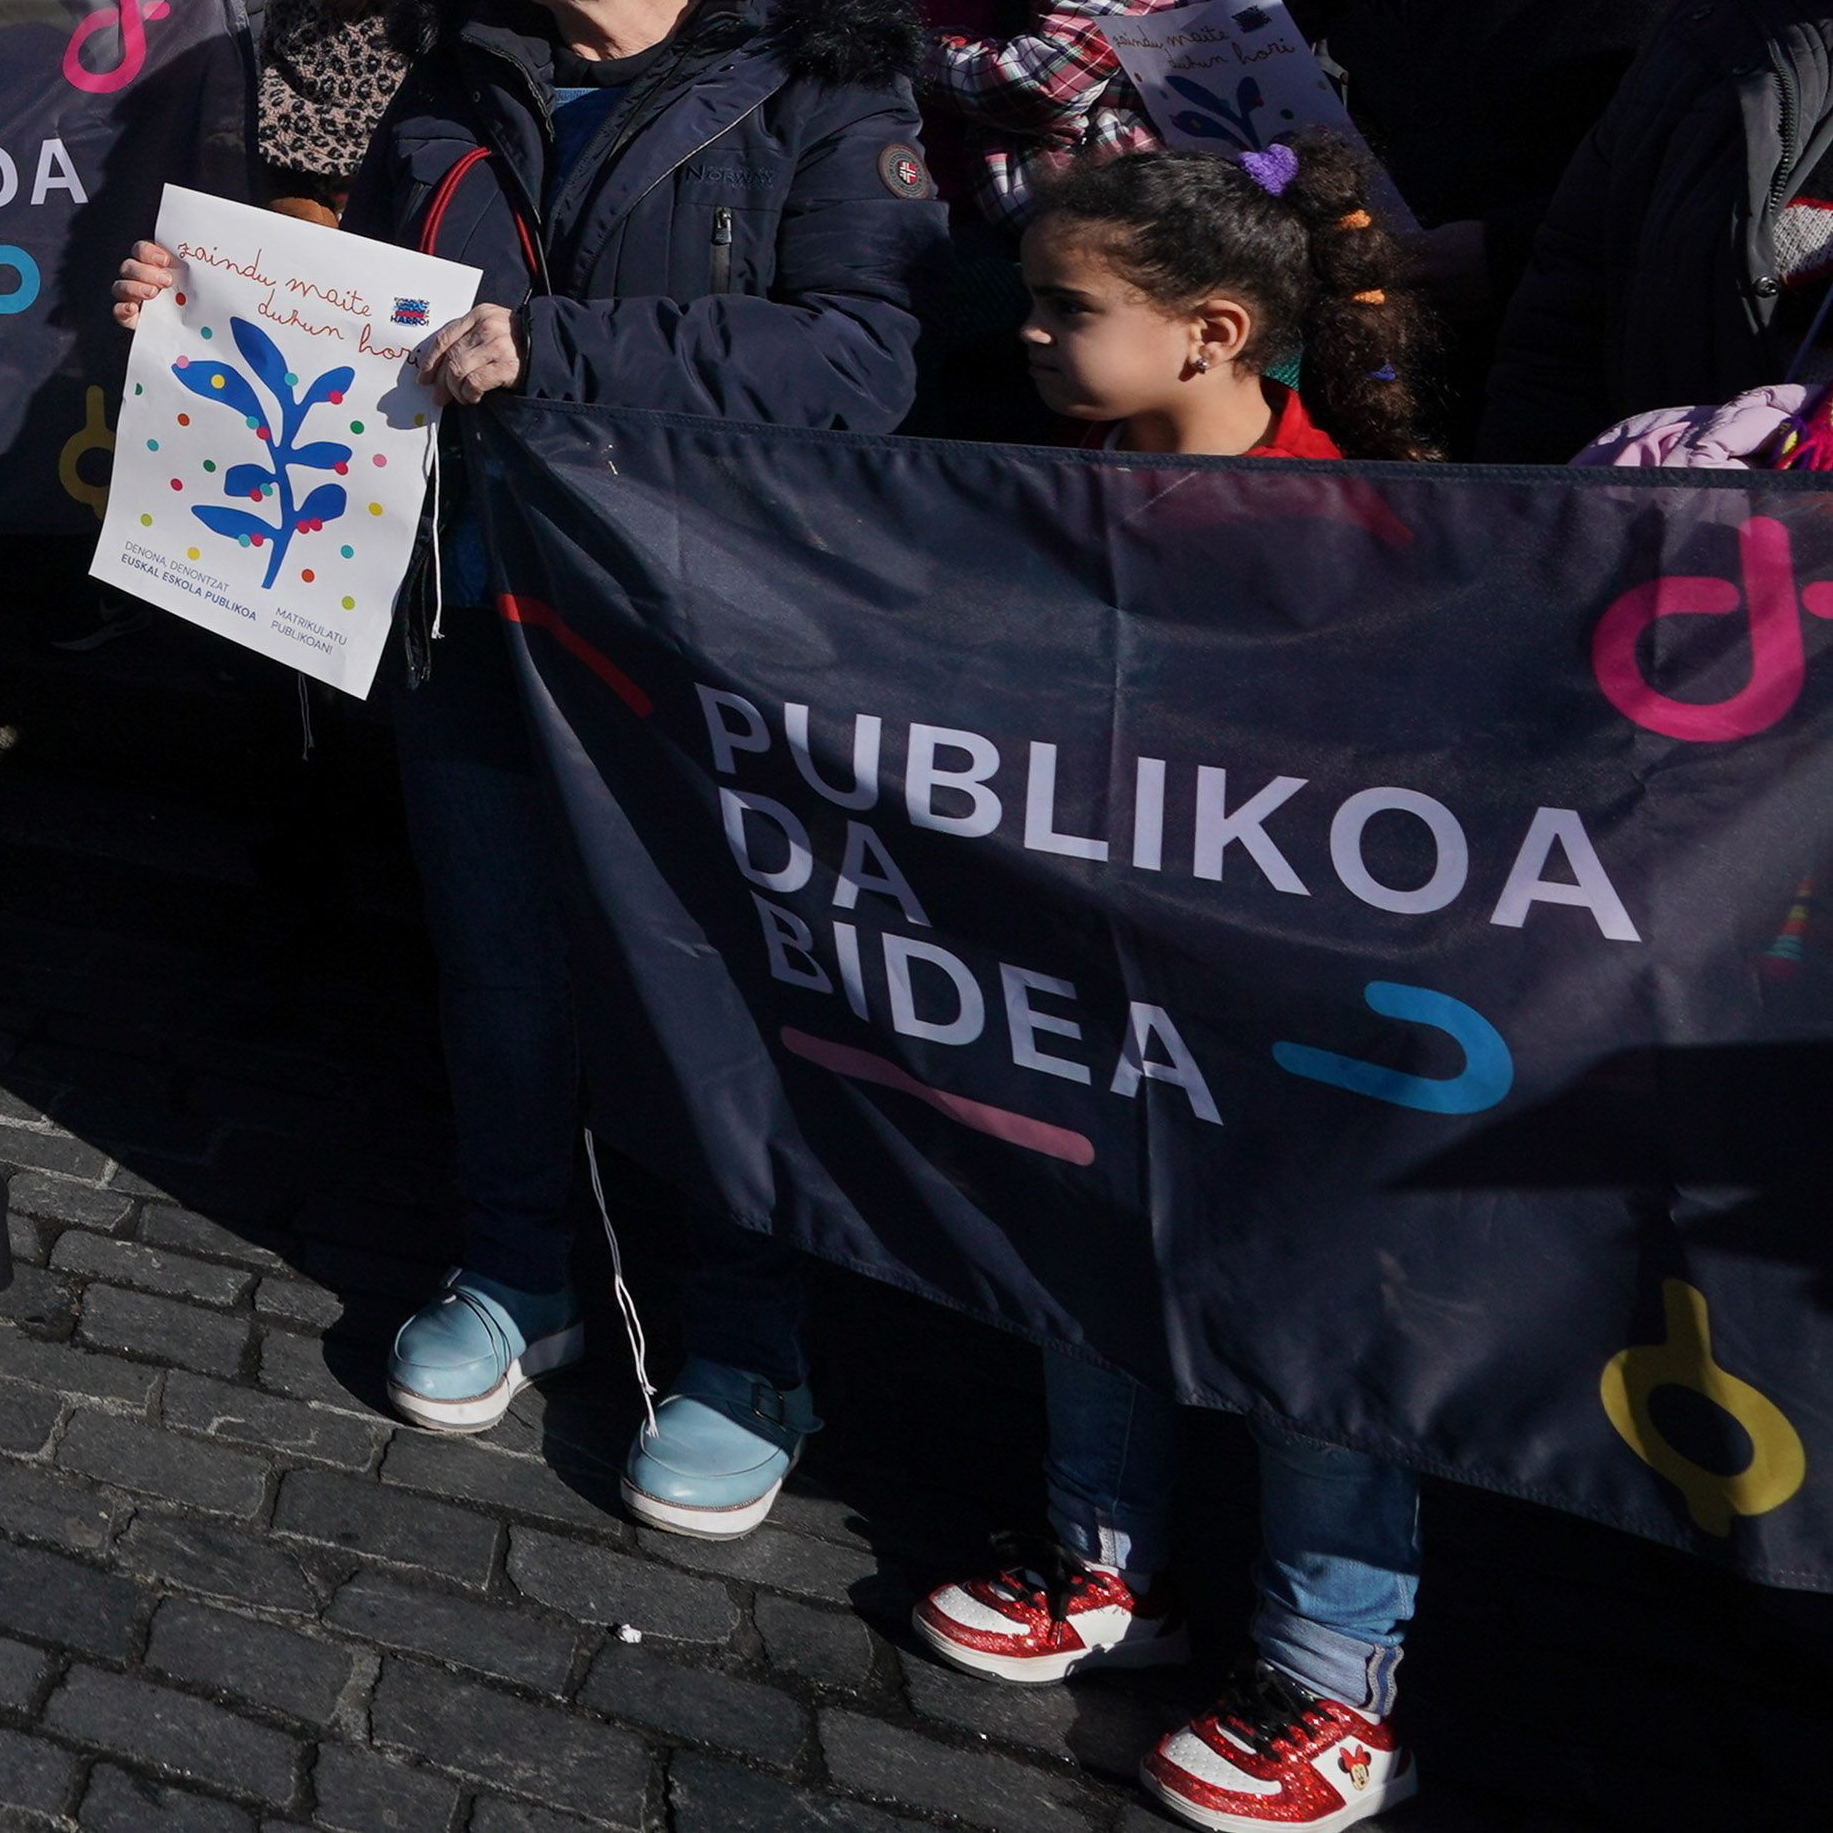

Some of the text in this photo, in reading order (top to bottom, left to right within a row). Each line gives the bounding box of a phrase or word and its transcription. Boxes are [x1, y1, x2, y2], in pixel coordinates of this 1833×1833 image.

[687, 161, 775, 186] NORWAY
[284, 277, 372, 317] maite
[358, 323, 421, 367] hori
[120, 552, 259, 622] EUSKAL ESKOLA PUBLIKOA
[169, 559, 231, 593] DENONTZAT
[275, 606, 348, 647] MATRIKULATU
[693, 680, 1642, 944] PUBLIKOA
[717, 785, 933, 928] DA
[749, 890, 1226, 1127] BIDEA
